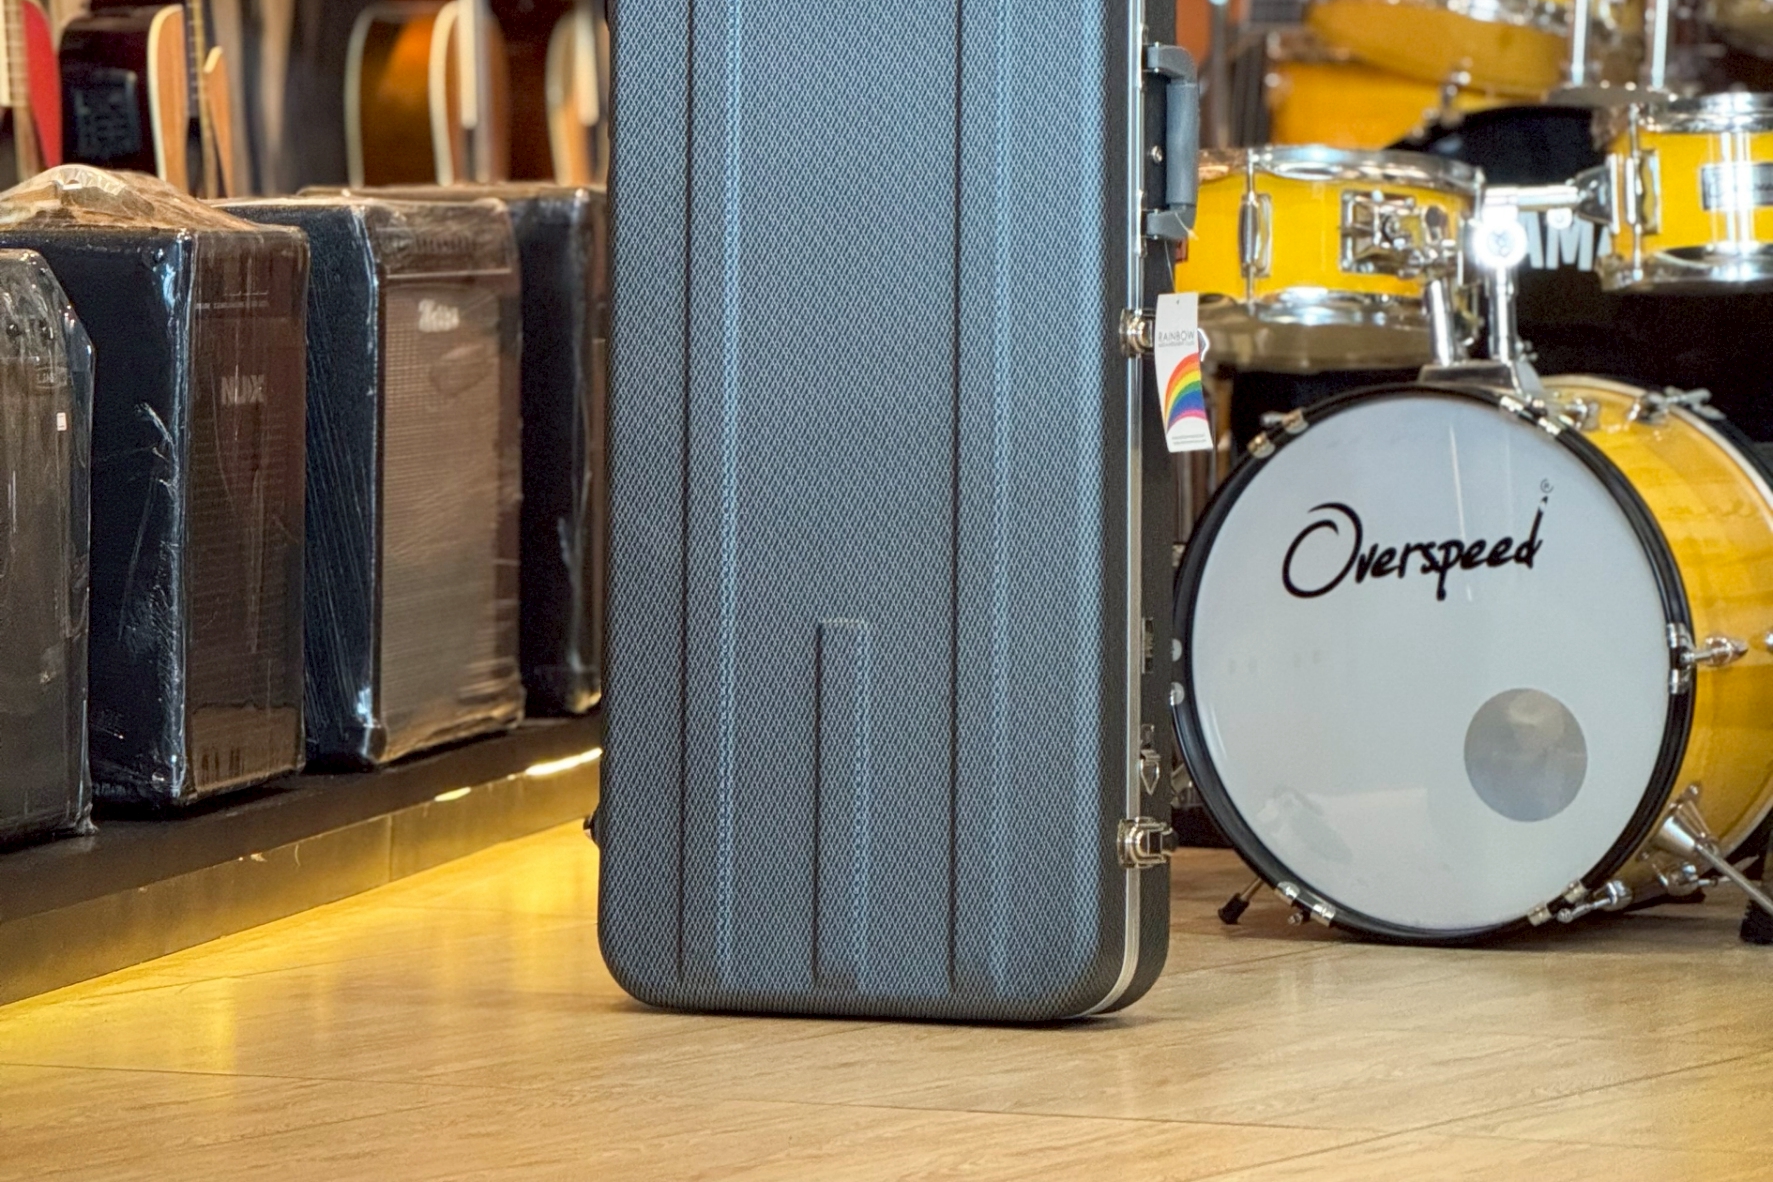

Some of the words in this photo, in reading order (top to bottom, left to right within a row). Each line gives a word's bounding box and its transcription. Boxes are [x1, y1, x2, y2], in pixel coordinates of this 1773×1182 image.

[1157, 329, 1195, 341] RAINBOW
[221, 374, 266, 405] NUX
[1282, 495, 1548, 602] Overspeed
